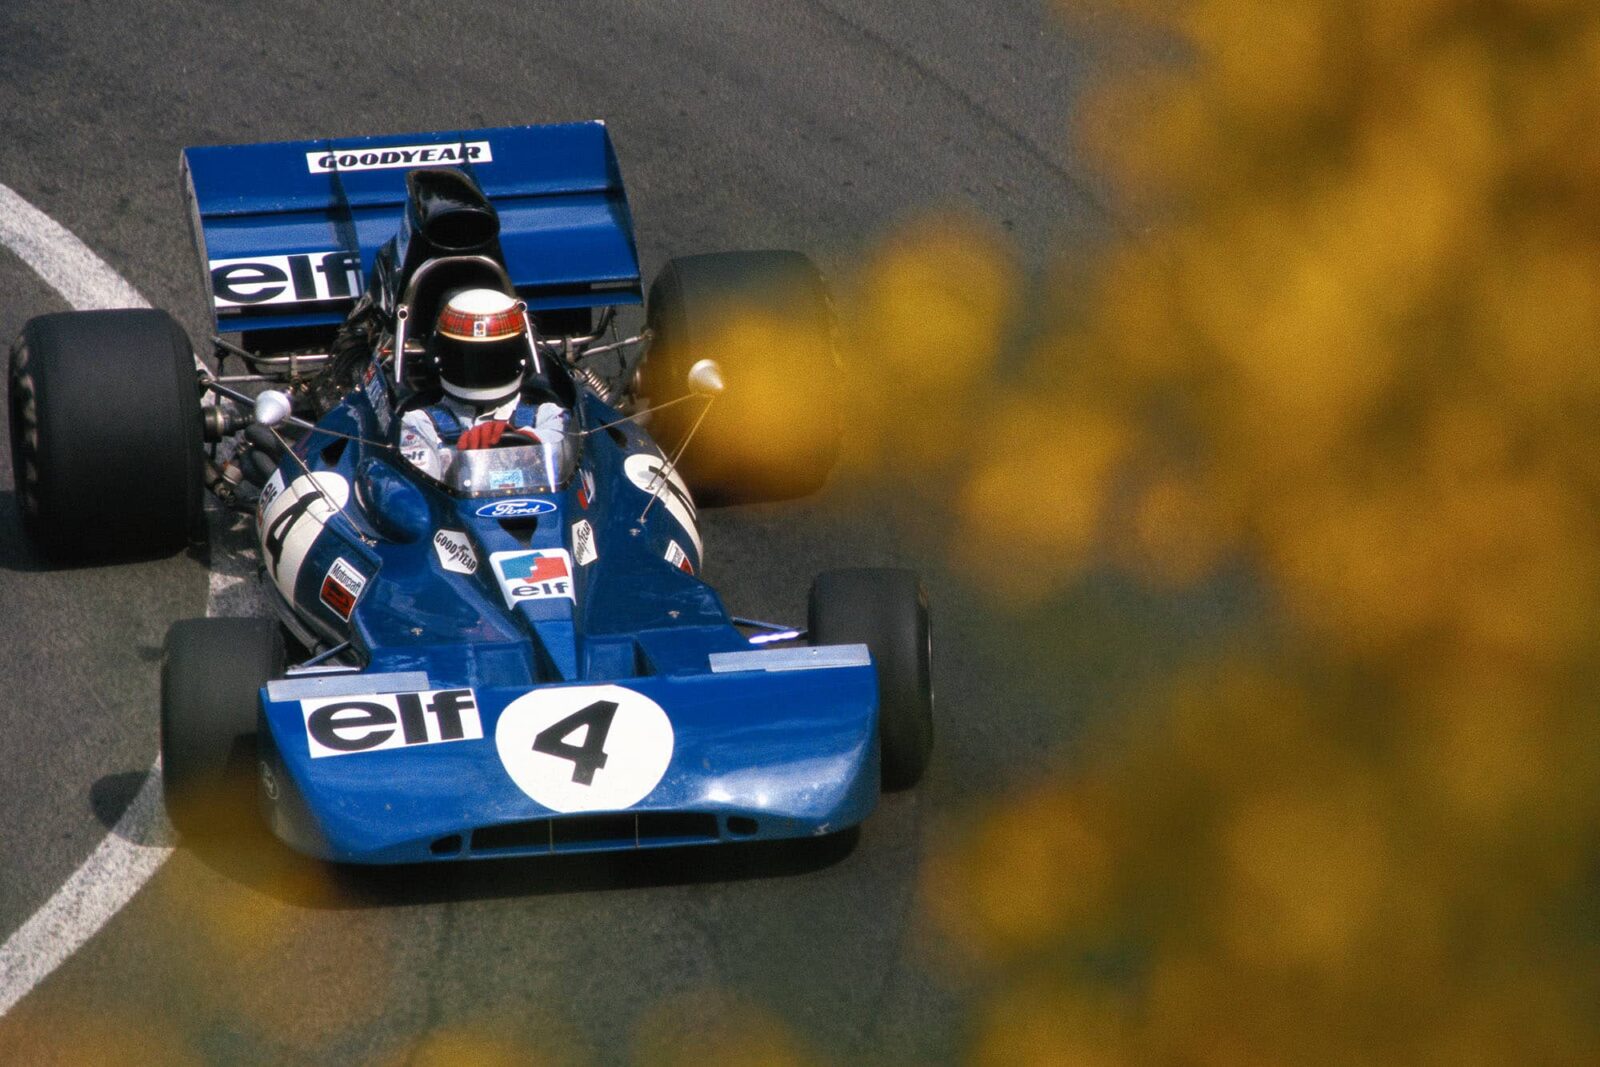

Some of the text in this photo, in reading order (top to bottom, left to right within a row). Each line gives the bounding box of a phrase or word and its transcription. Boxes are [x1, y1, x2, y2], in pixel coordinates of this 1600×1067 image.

[318, 146, 481, 169] GOODYEAR
[210, 251, 361, 304] elf
[491, 501, 541, 516] Ford
[266, 490, 325, 583] 4
[511, 581, 569, 597] elf
[307, 688, 475, 752] elf
[531, 699, 620, 787] 4
